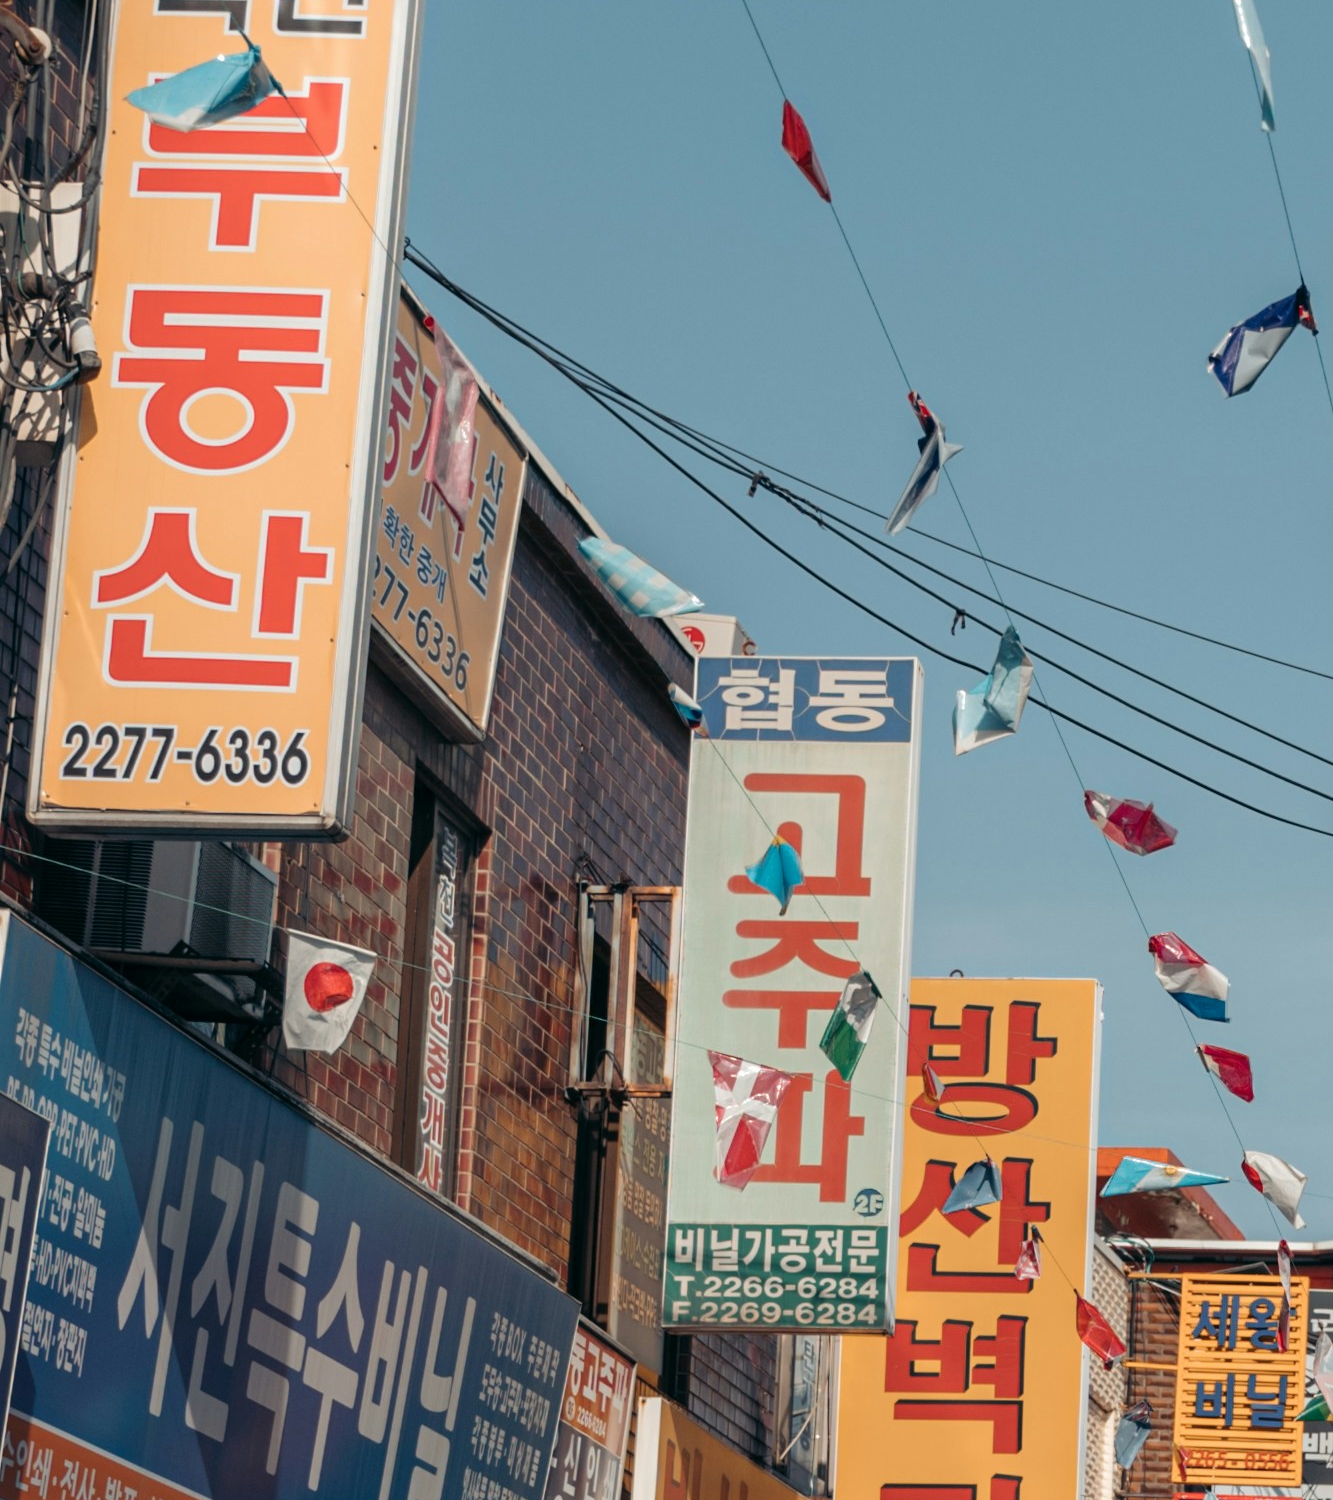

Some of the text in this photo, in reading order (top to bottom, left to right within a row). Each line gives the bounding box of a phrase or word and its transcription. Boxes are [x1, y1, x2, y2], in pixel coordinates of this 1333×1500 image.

[90, 75, 350, 691] 부동산
[719, 668, 894, 732] 협동
[60, 722, 311, 790] 2277-6336
[855, 1192, 881, 1216] 2F
[674, 1228, 879, 1274] 비닐가공전문
[671, 1302, 878, 1326] F.2269-6284
[674, 1276, 879, 1301] T.2266-6284
[1195, 1372, 1288, 1428] 비닐
